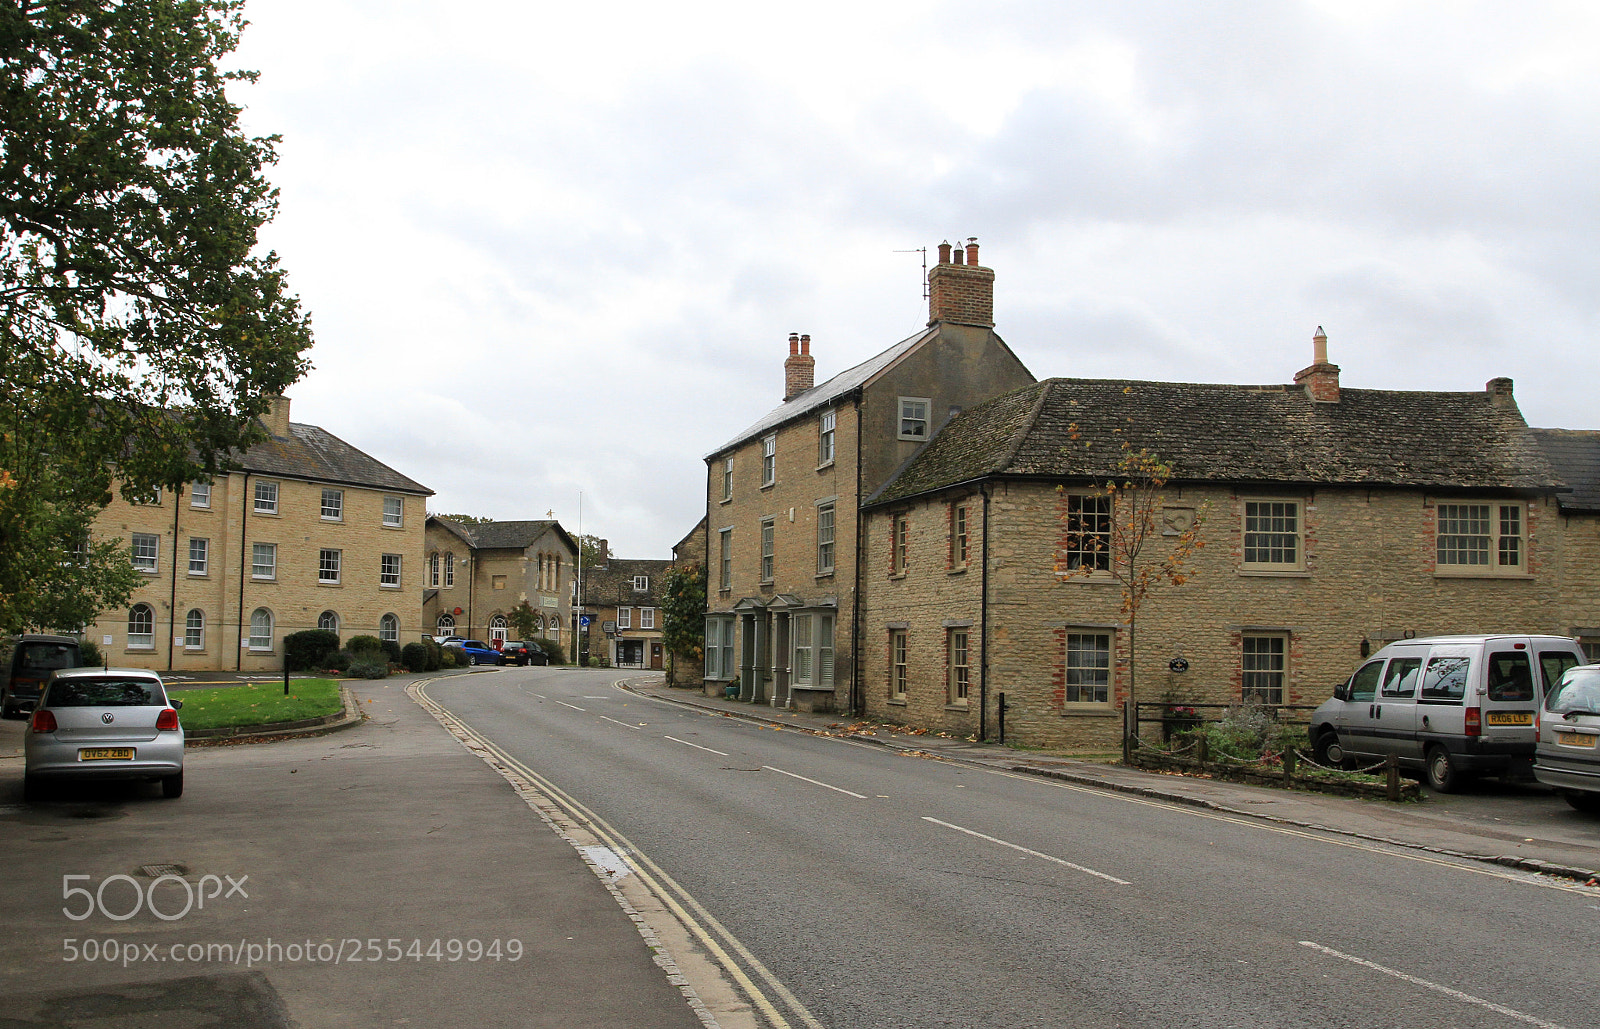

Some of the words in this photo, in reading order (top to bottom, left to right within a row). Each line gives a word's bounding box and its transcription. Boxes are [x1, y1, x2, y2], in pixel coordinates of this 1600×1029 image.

[1491, 714, 1512, 723] RX06
[1513, 714, 1529, 723] LLF
[84, 749, 109, 758] OV62
